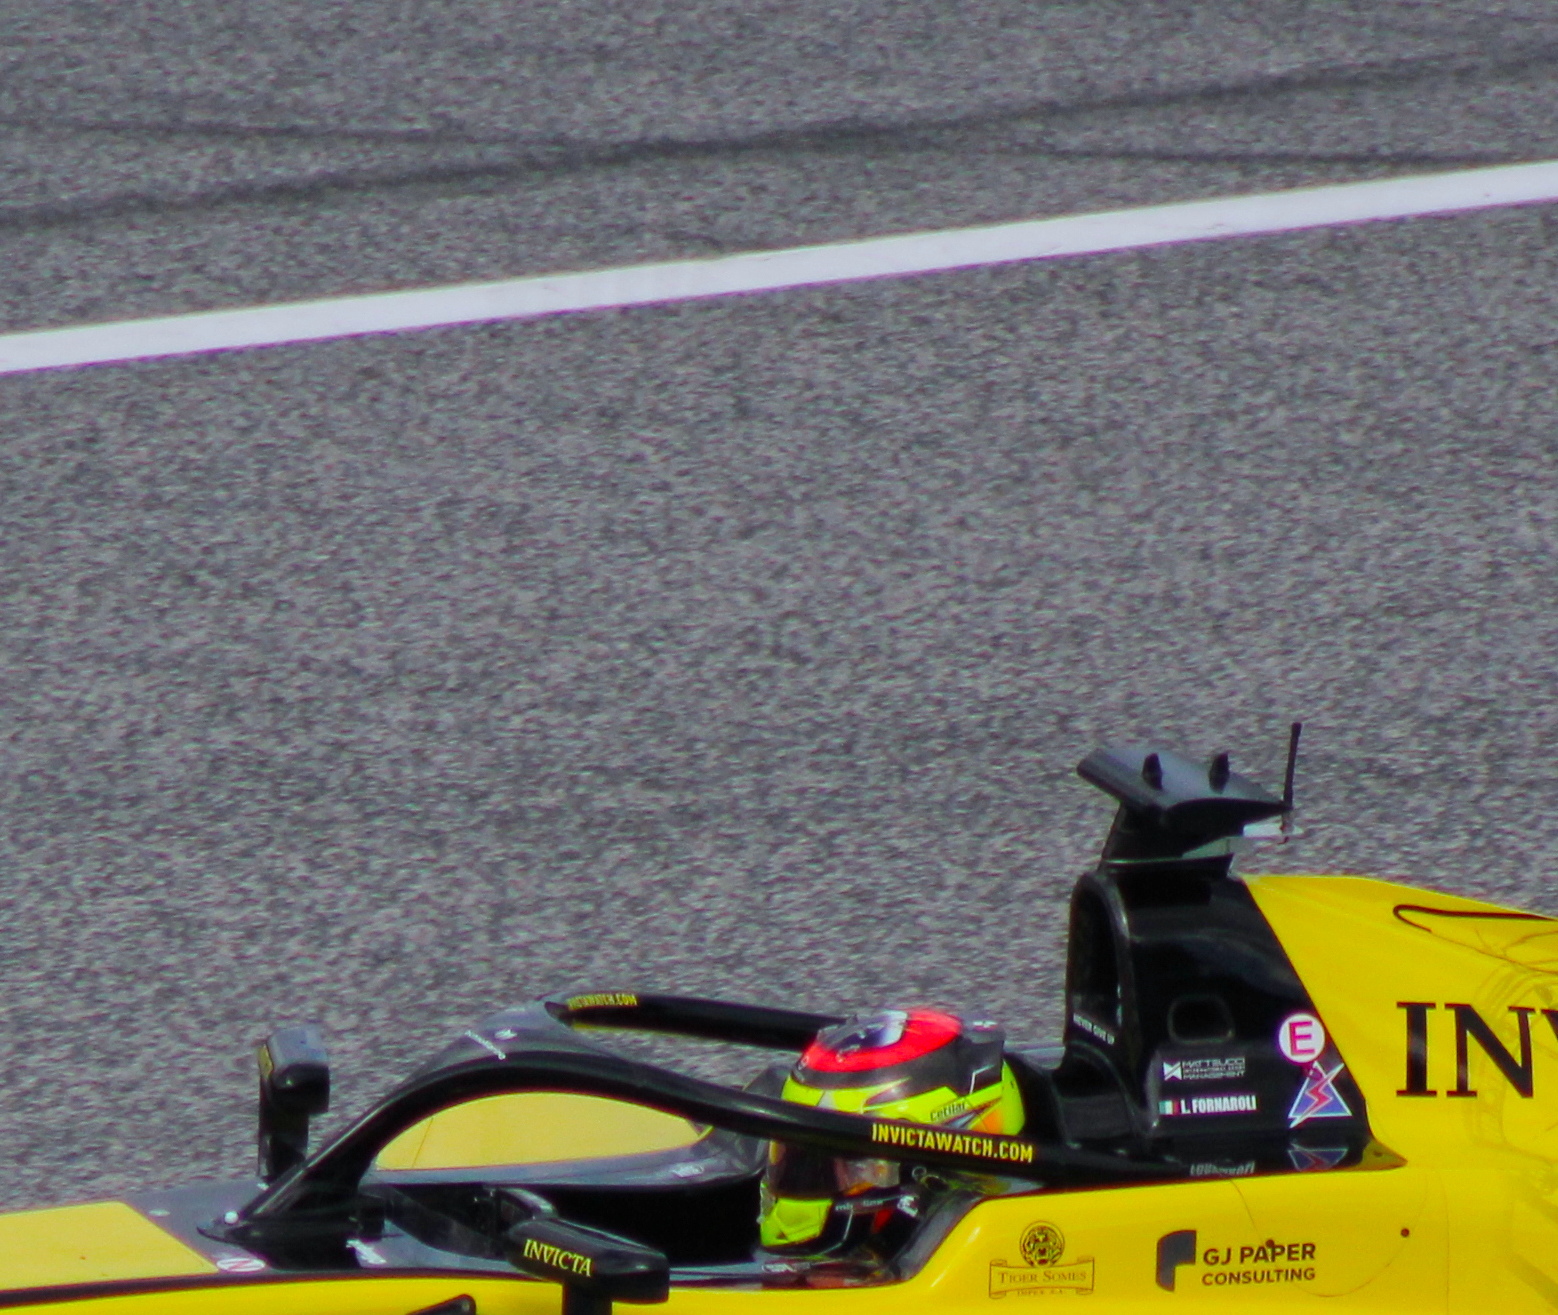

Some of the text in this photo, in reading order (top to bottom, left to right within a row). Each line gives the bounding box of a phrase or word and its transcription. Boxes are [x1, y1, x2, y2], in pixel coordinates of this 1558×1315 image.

[1289, 1019, 1316, 1056] E
[1191, 1095, 1257, 1114] FORNAROLI
[871, 1123, 1034, 1163] INVICTAWATCH.COM
[522, 1237, 593, 1277] INVICTA
[1203, 1242, 1316, 1266] GJ PAPER
[1201, 1267, 1316, 1286] CONSULTING
